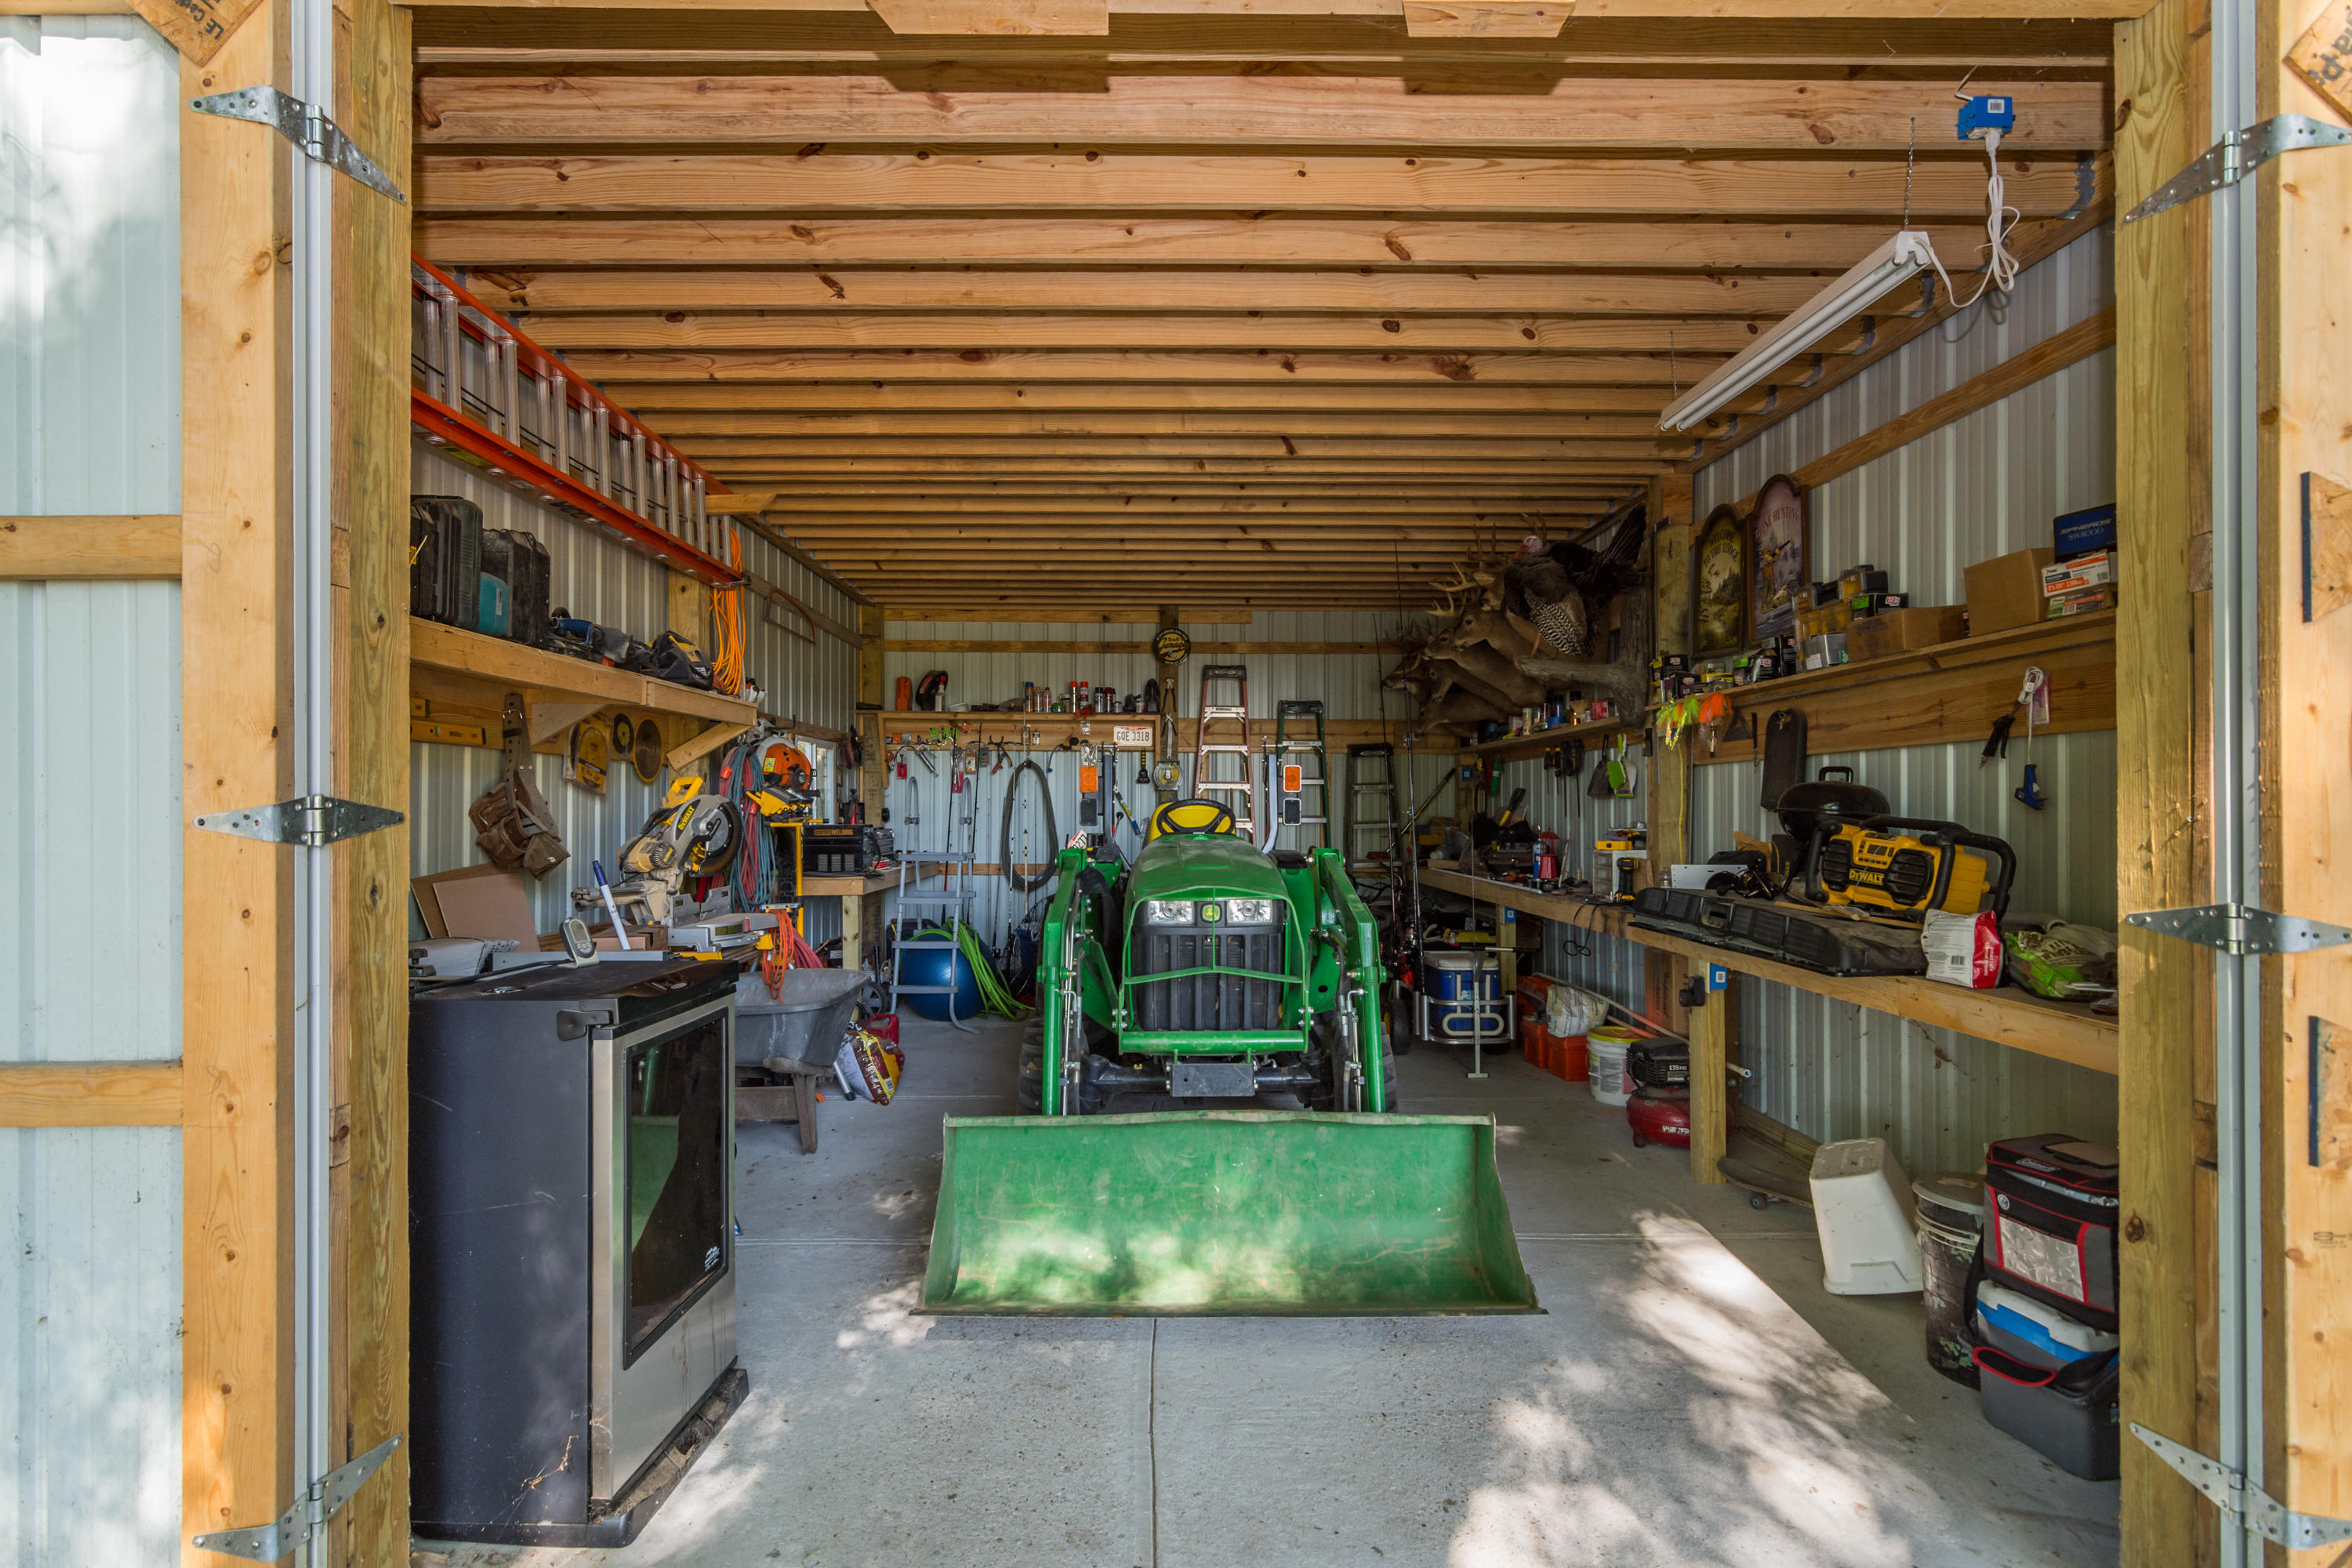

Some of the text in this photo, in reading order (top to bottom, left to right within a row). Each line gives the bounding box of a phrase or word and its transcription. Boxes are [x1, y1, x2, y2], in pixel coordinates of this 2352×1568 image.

[1756, 506, 1800, 539] GONE HUNTING
[1711, 543, 1721, 559] THE
[1722, 541, 1739, 563] LODGE
[1132, 731, 1149, 742] 3318
